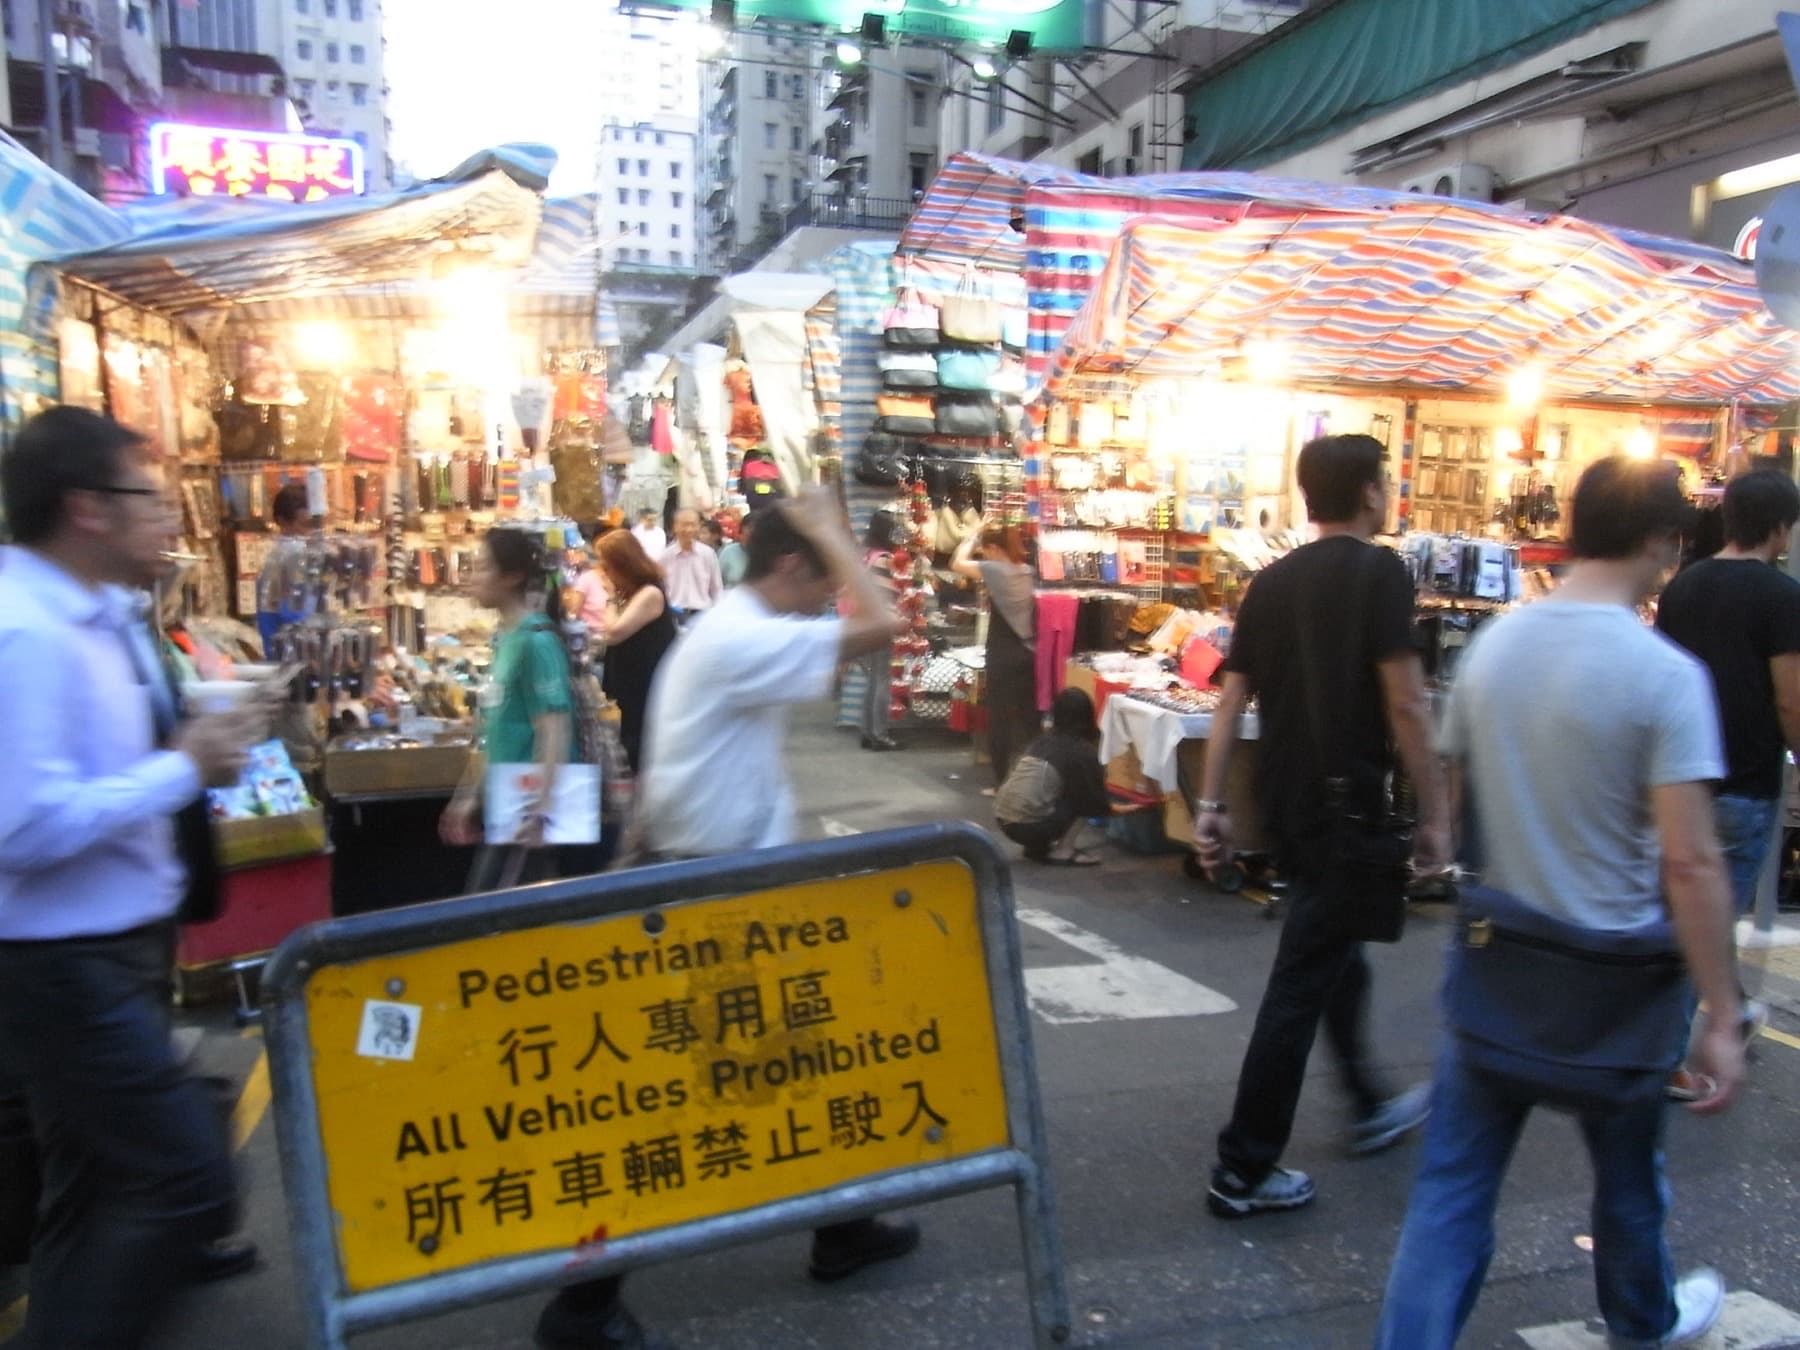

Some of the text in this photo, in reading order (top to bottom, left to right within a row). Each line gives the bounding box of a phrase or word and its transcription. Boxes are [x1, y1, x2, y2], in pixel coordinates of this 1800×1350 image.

[459, 915, 848, 1008] Pedestrian Area
[396, 1020, 941, 1161] All Vehicles Prohibited
[499, 970, 836, 1085] 行人專用區
[405, 1081, 948, 1243] 所有車輛禁止駛入
